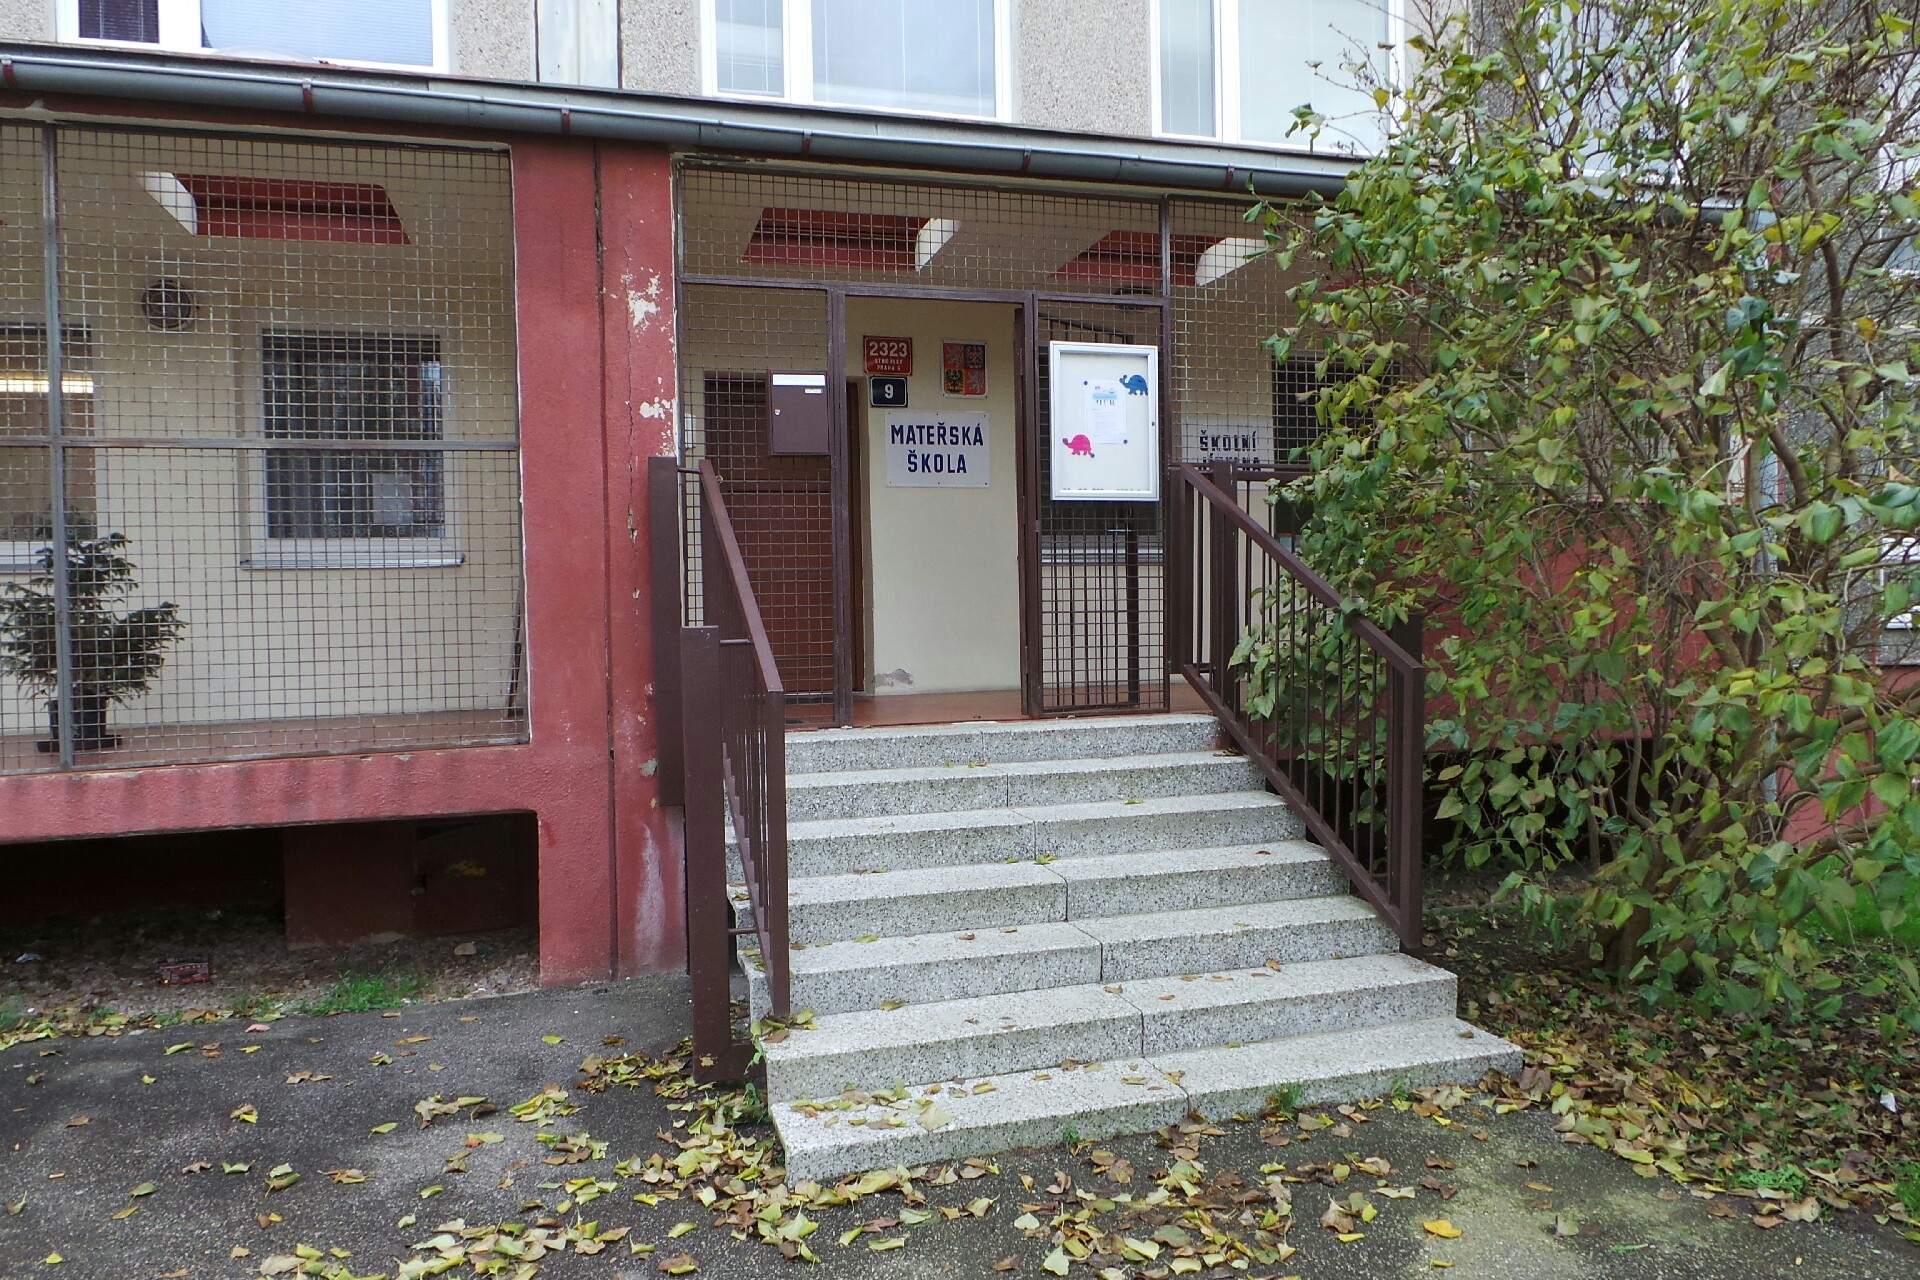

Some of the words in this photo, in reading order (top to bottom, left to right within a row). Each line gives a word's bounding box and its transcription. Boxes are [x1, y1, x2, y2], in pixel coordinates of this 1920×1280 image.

[869, 341, 908, 357] 2323
[884, 383, 894, 399] 9
[890, 422, 984, 446] MATEŘSKÁ
[1199, 429, 1257, 452] ŠKOLNÍ
[907, 449, 968, 474] ŠKOLA
